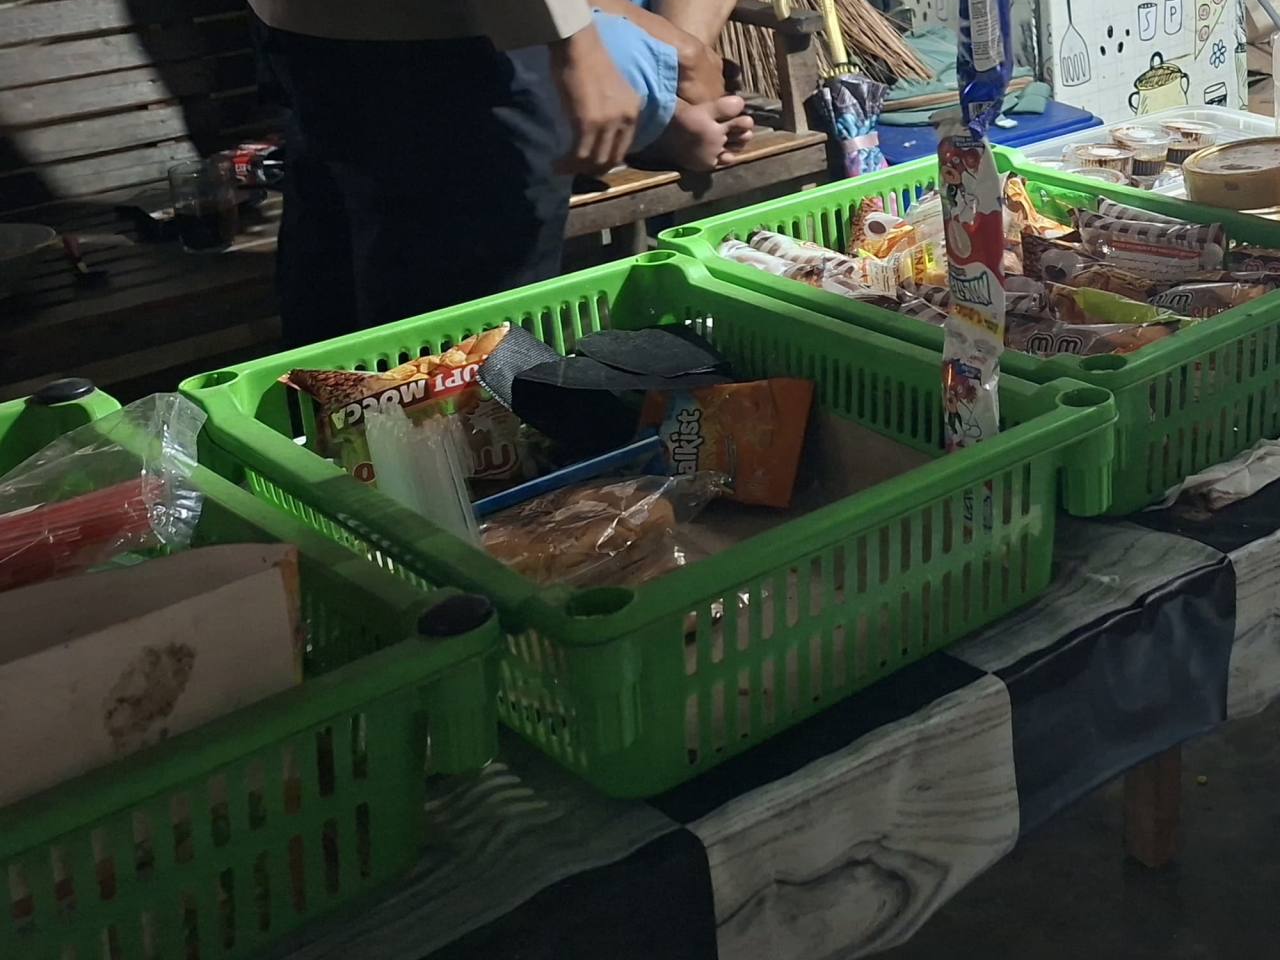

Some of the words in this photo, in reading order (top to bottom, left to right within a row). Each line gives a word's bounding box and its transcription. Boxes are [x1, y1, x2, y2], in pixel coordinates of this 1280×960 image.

[1143, 10, 1151, 33] S
[1170, 5, 1177, 25] P
[434, 363, 480, 392] OPI
[331, 379, 426, 431] MOCCA
[671, 408, 704, 474] alkist
